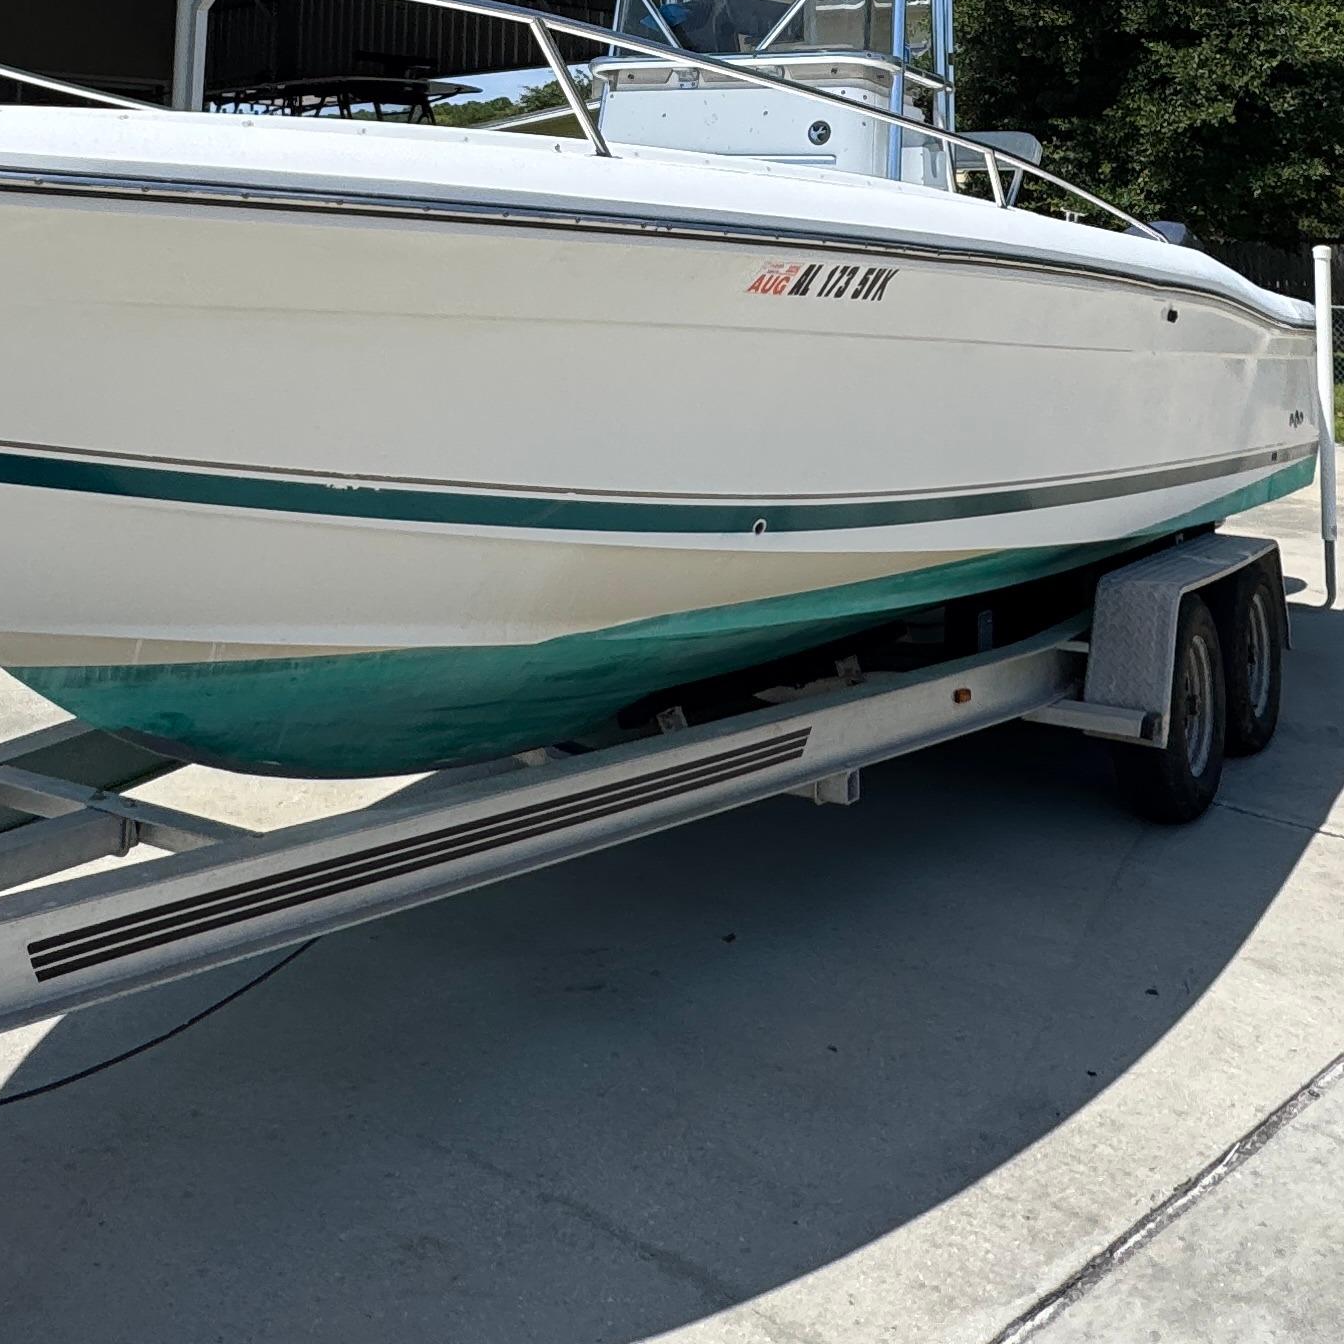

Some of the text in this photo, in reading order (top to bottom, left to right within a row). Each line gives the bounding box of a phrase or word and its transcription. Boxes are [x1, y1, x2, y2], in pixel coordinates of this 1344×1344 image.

[747, 274, 791, 296] AUG
[787, 264, 824, 297] AL
[816, 265, 860, 299] 173
